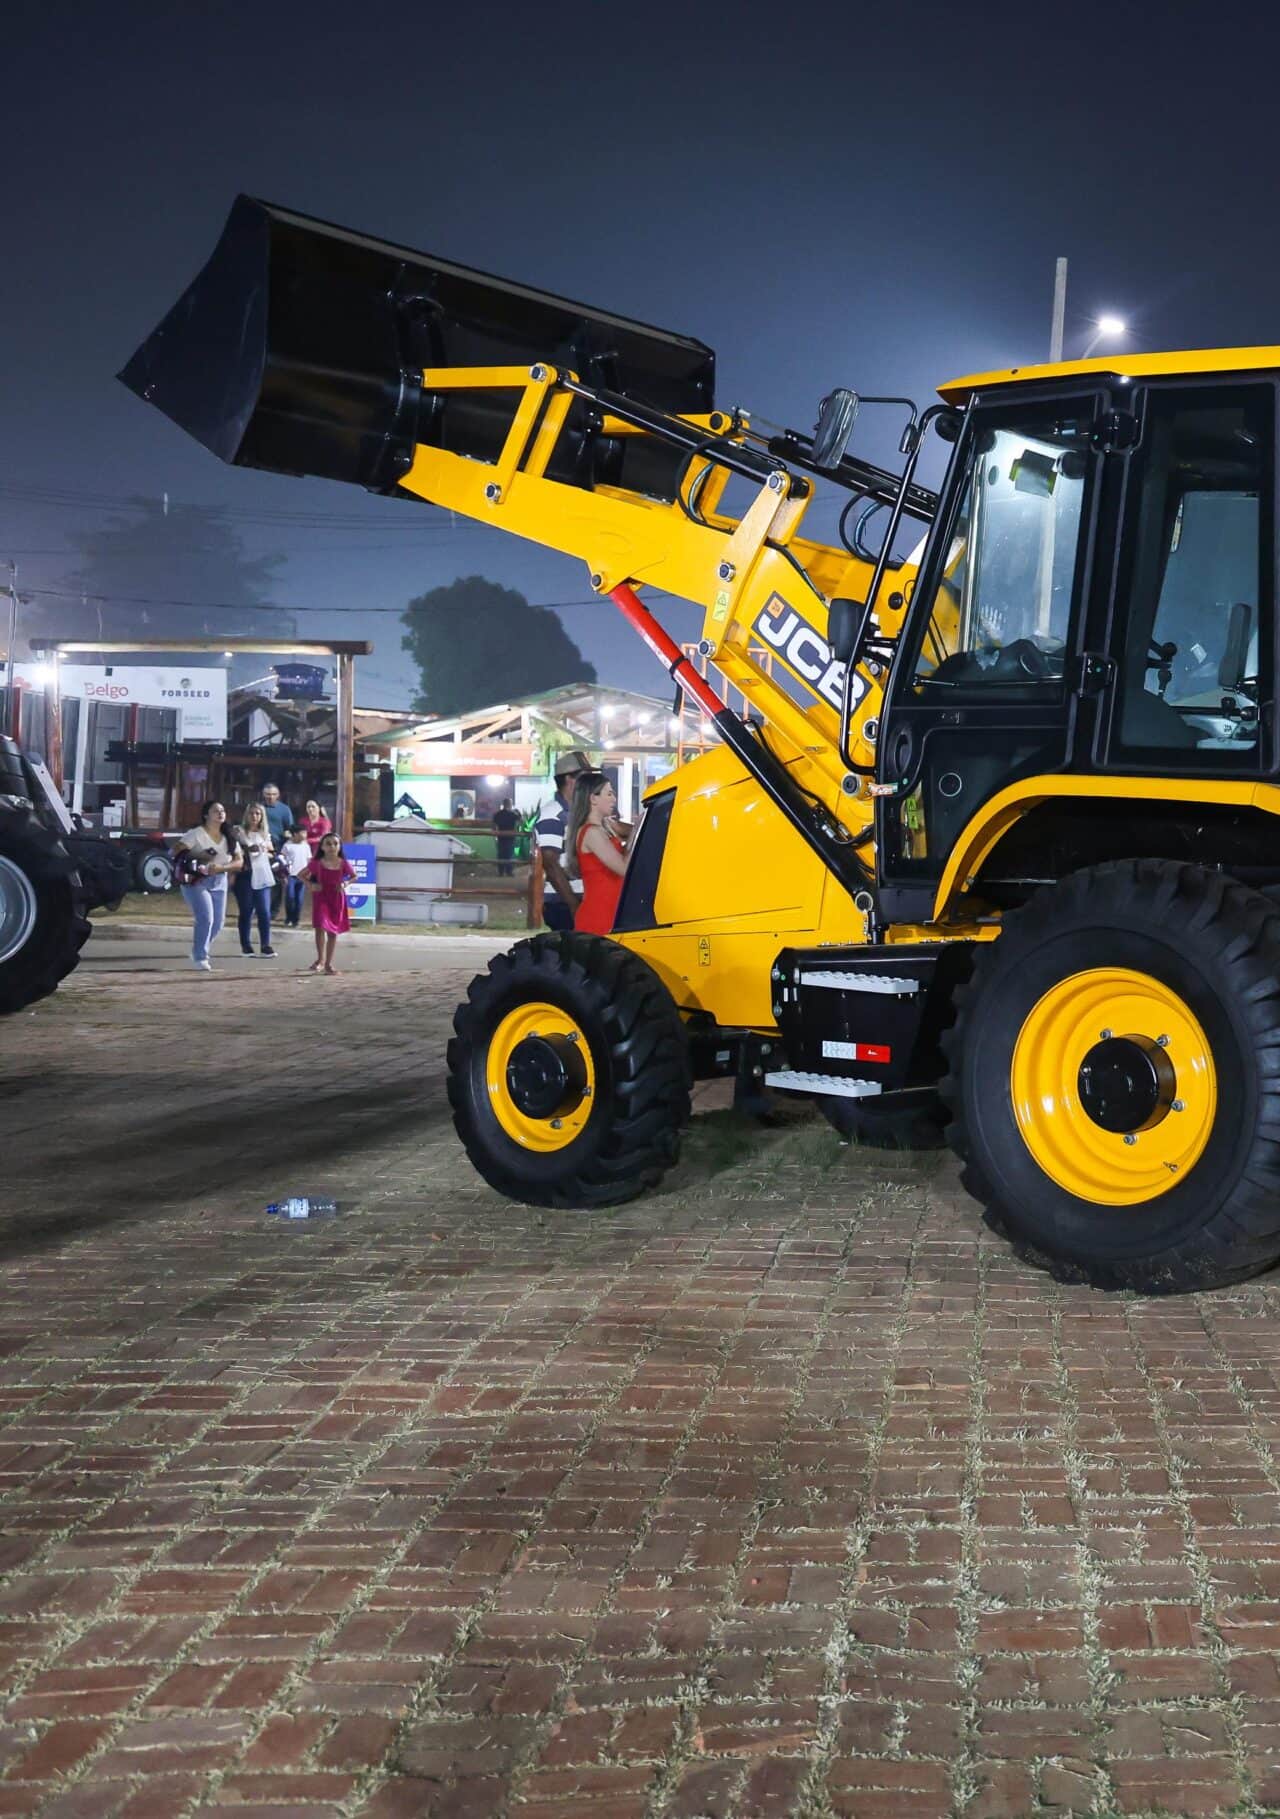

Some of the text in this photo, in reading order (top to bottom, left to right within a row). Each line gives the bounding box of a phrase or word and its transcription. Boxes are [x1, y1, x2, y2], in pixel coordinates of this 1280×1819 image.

[758, 613, 865, 713] JCB
[84, 682, 129, 699] Belgo
[161, 689, 211, 698] FORSEED
